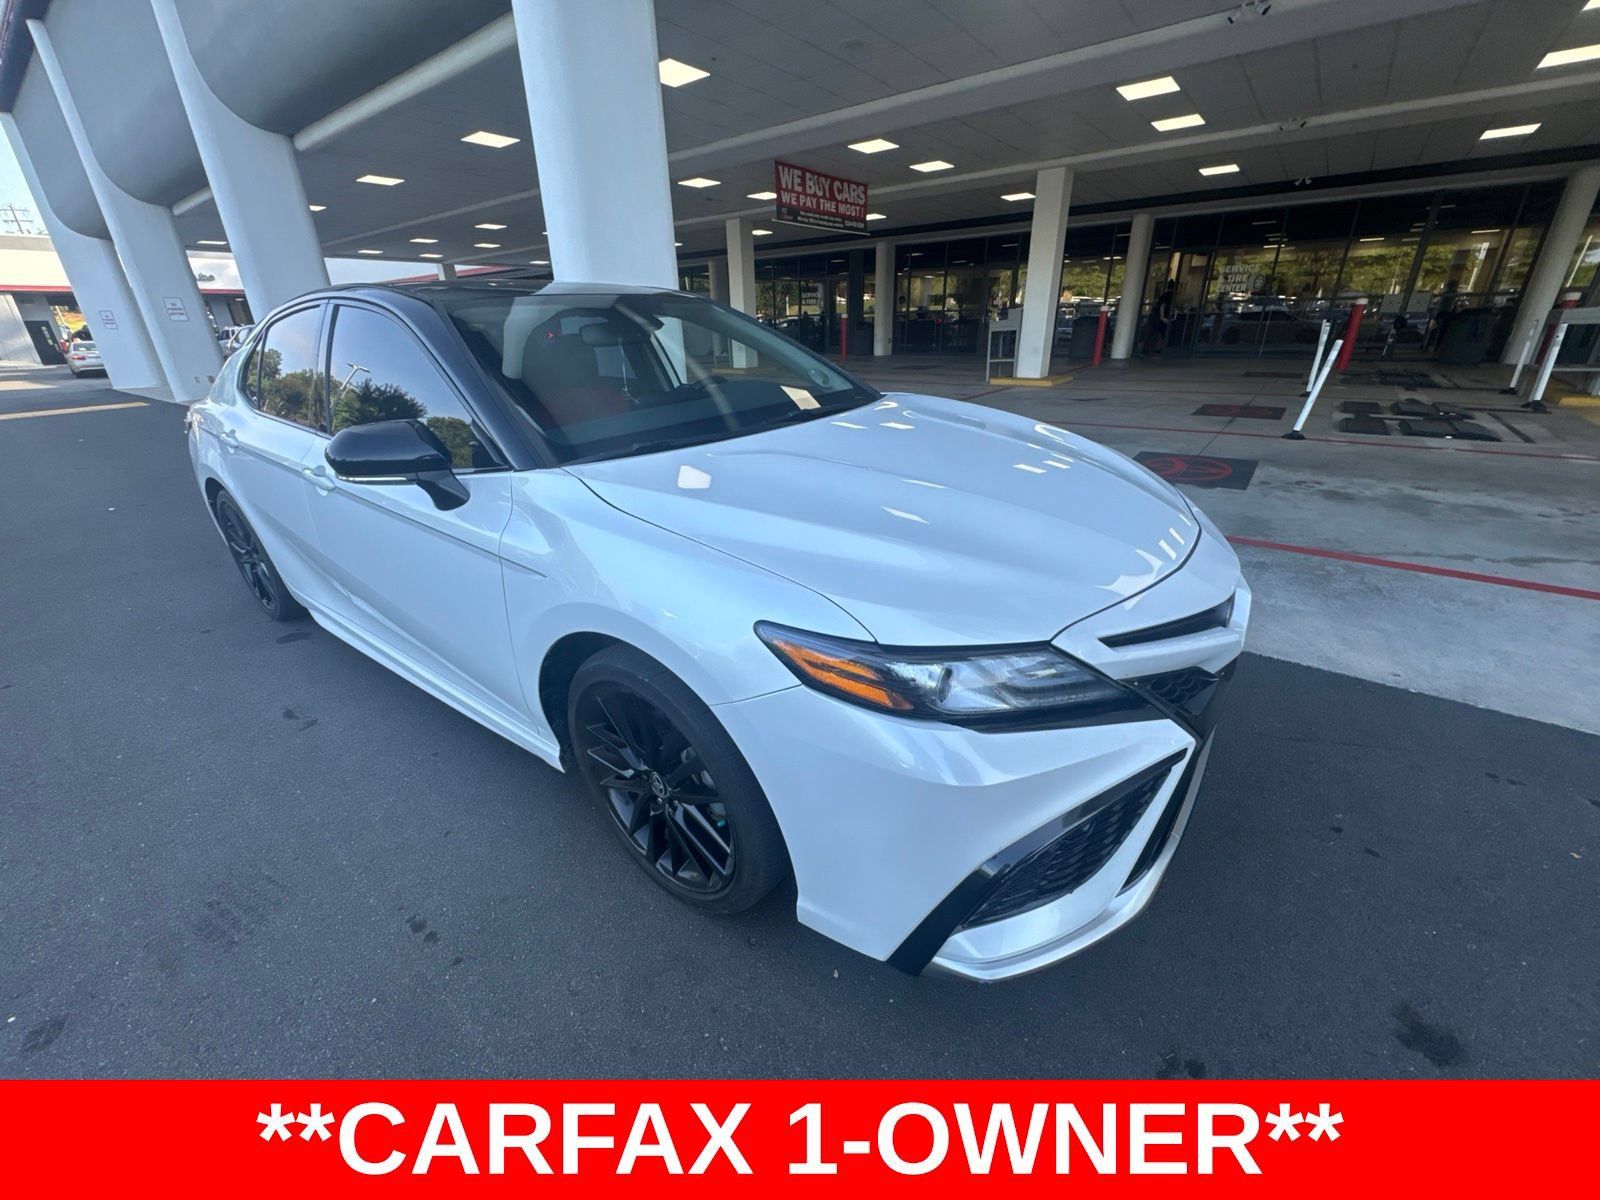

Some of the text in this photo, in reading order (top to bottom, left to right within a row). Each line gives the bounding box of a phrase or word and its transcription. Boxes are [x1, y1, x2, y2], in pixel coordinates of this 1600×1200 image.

[778, 165, 865, 205] WE BUY CARS
[781, 190, 798, 205] WE
[799, 194, 817, 209] PAY
[819, 199, 837, 212] THE
[1220, 263, 1261, 273] SERVICE
[1227, 274, 1249, 282] TIRE
